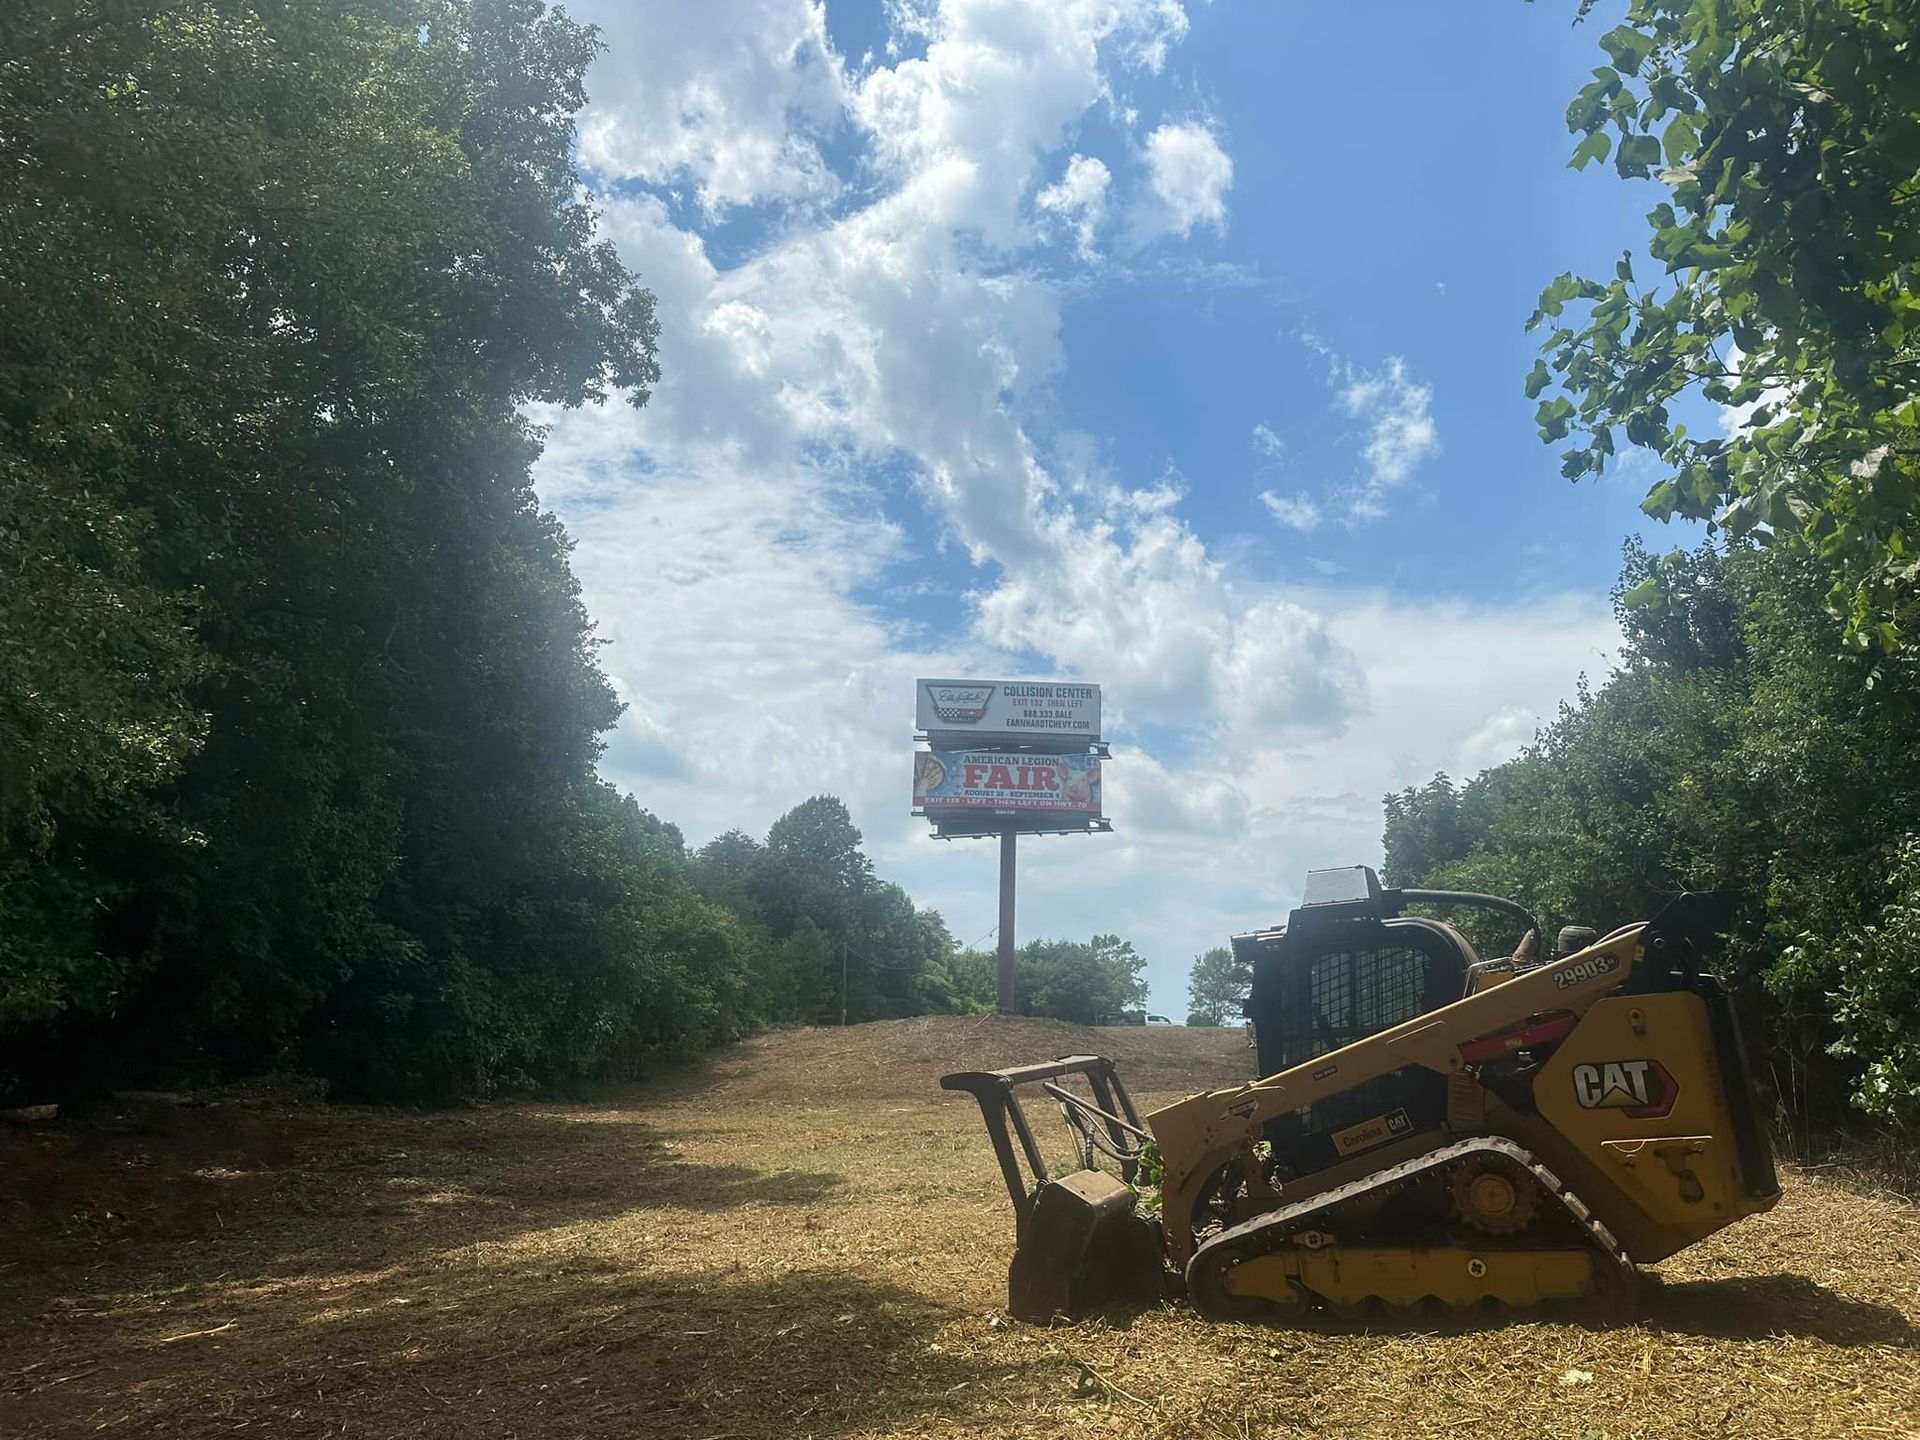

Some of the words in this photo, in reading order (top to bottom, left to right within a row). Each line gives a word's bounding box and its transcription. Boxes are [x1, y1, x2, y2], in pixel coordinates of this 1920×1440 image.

[1003, 686, 1053, 698] COLLISION
[1056, 687, 1093, 699] CENTER
[1012, 698, 1028, 706] EXIT
[1047, 699, 1066, 708] THEN
[1068, 700, 1083, 708] LEFT
[1006, 718, 1090, 729] EARNHARDTCHEVY.COM
[964, 755, 1020, 765] AMERICAN
[1022, 757, 1060, 767] LEGION
[962, 764, 1060, 791] FAIR
[1009, 791, 1055, 799] SEPTEMBER
[993, 798, 1017, 806] THEN
[1573, 1061, 1649, 1108] CAT
[1342, 1127, 1383, 1148] Carolina
[1387, 1115, 1407, 1131] CAT
